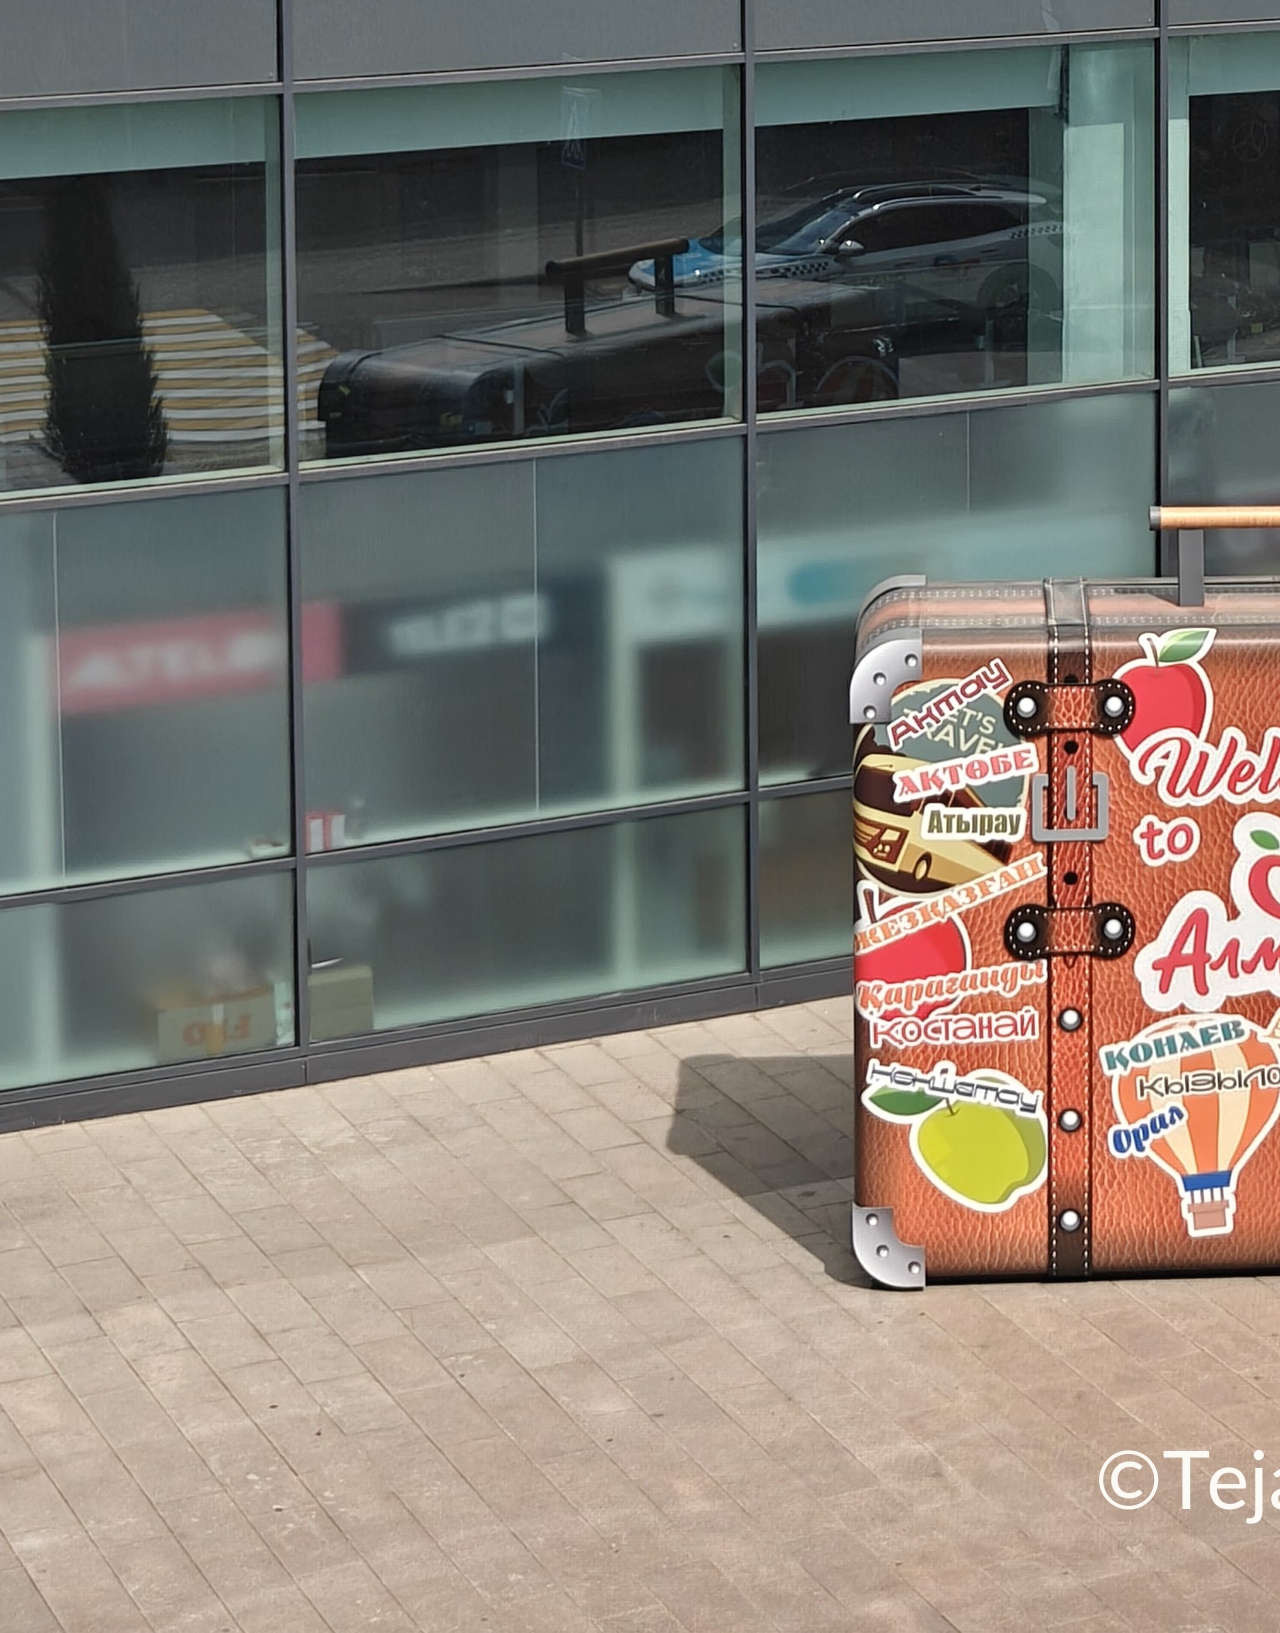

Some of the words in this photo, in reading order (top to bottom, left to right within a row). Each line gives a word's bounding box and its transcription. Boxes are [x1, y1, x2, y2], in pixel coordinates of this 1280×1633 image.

[927, 809, 1022, 836] Атырау
[1140, 821, 1195, 860] to
[1112, 1105, 1185, 1155] Орал
